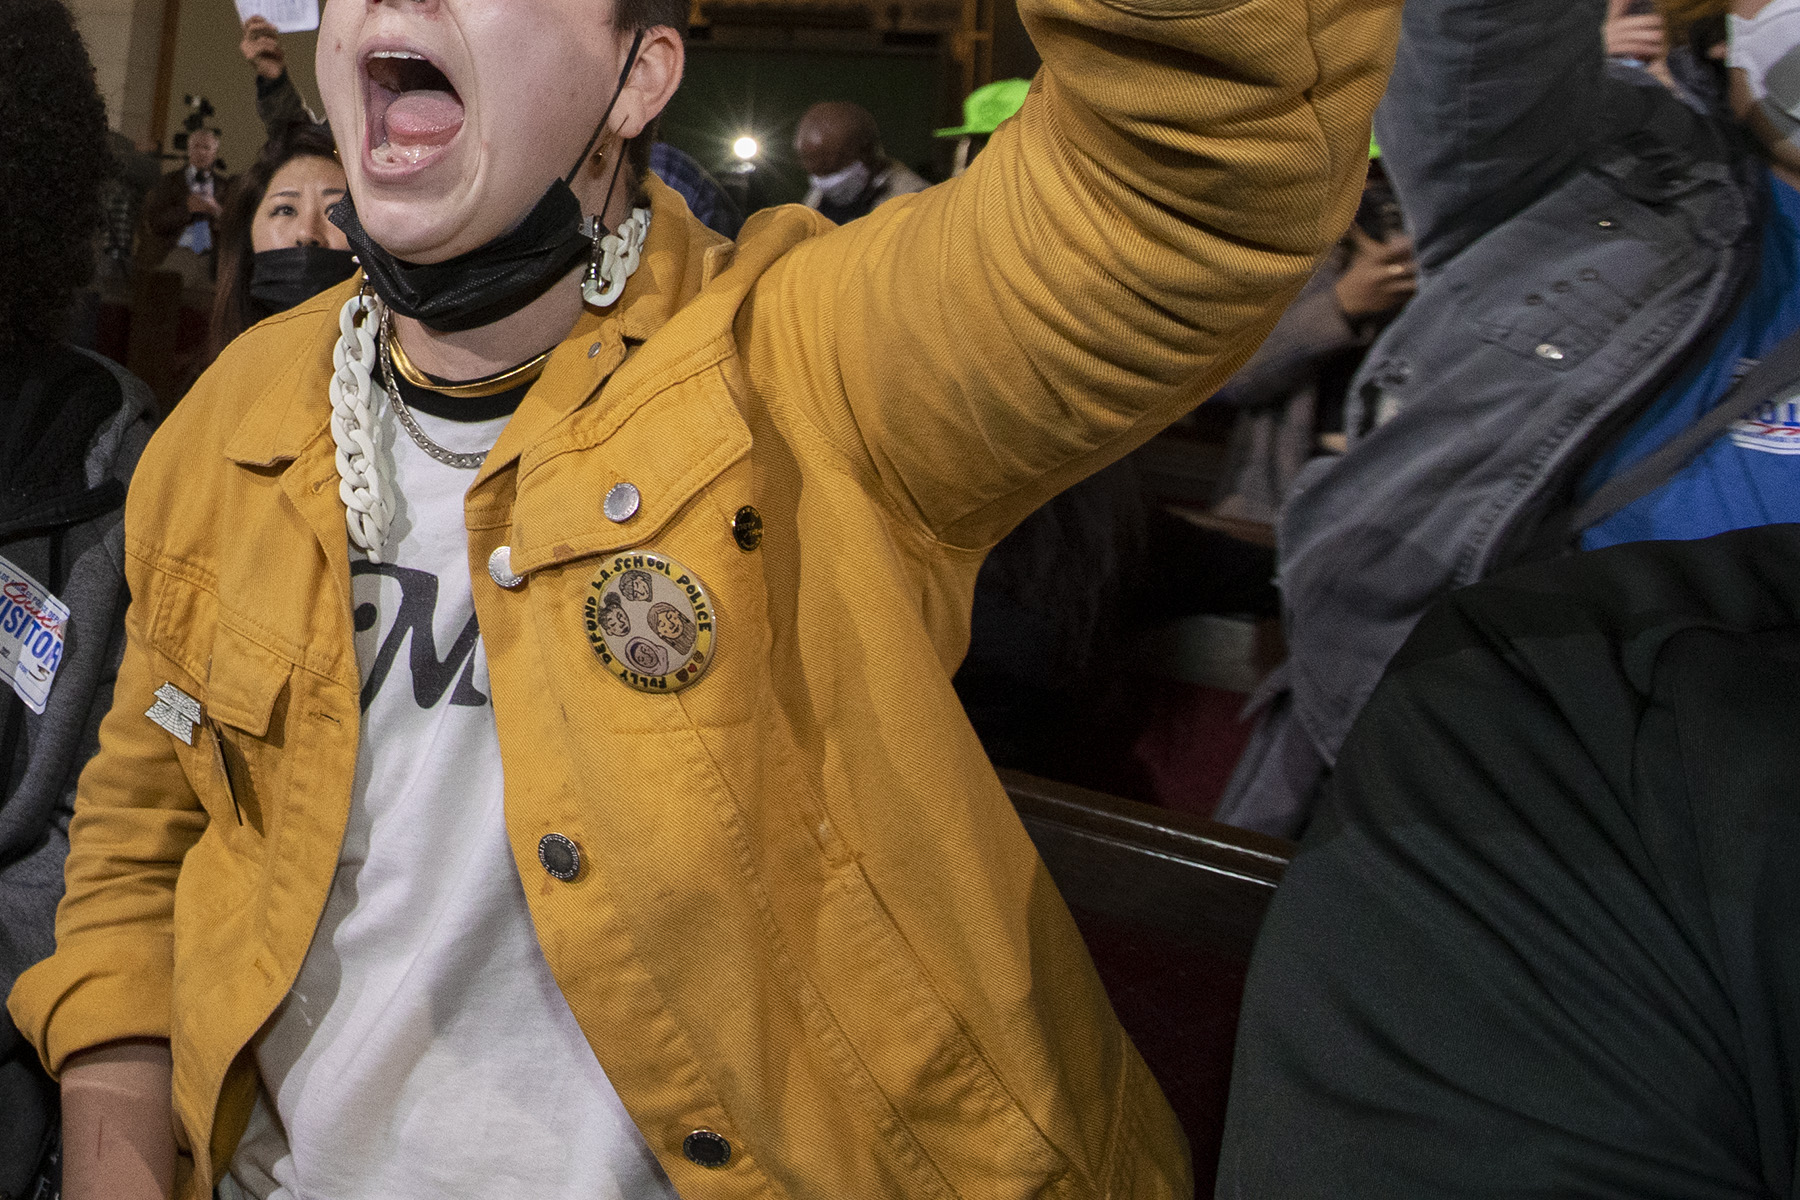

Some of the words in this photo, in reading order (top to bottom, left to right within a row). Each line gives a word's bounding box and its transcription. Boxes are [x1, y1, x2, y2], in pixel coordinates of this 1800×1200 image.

[613, 555, 671, 576] SCHOOL
[676, 574, 712, 632] POLICE
[583, 596, 613, 665] DEFUND
[619, 669, 668, 689] FULLY
